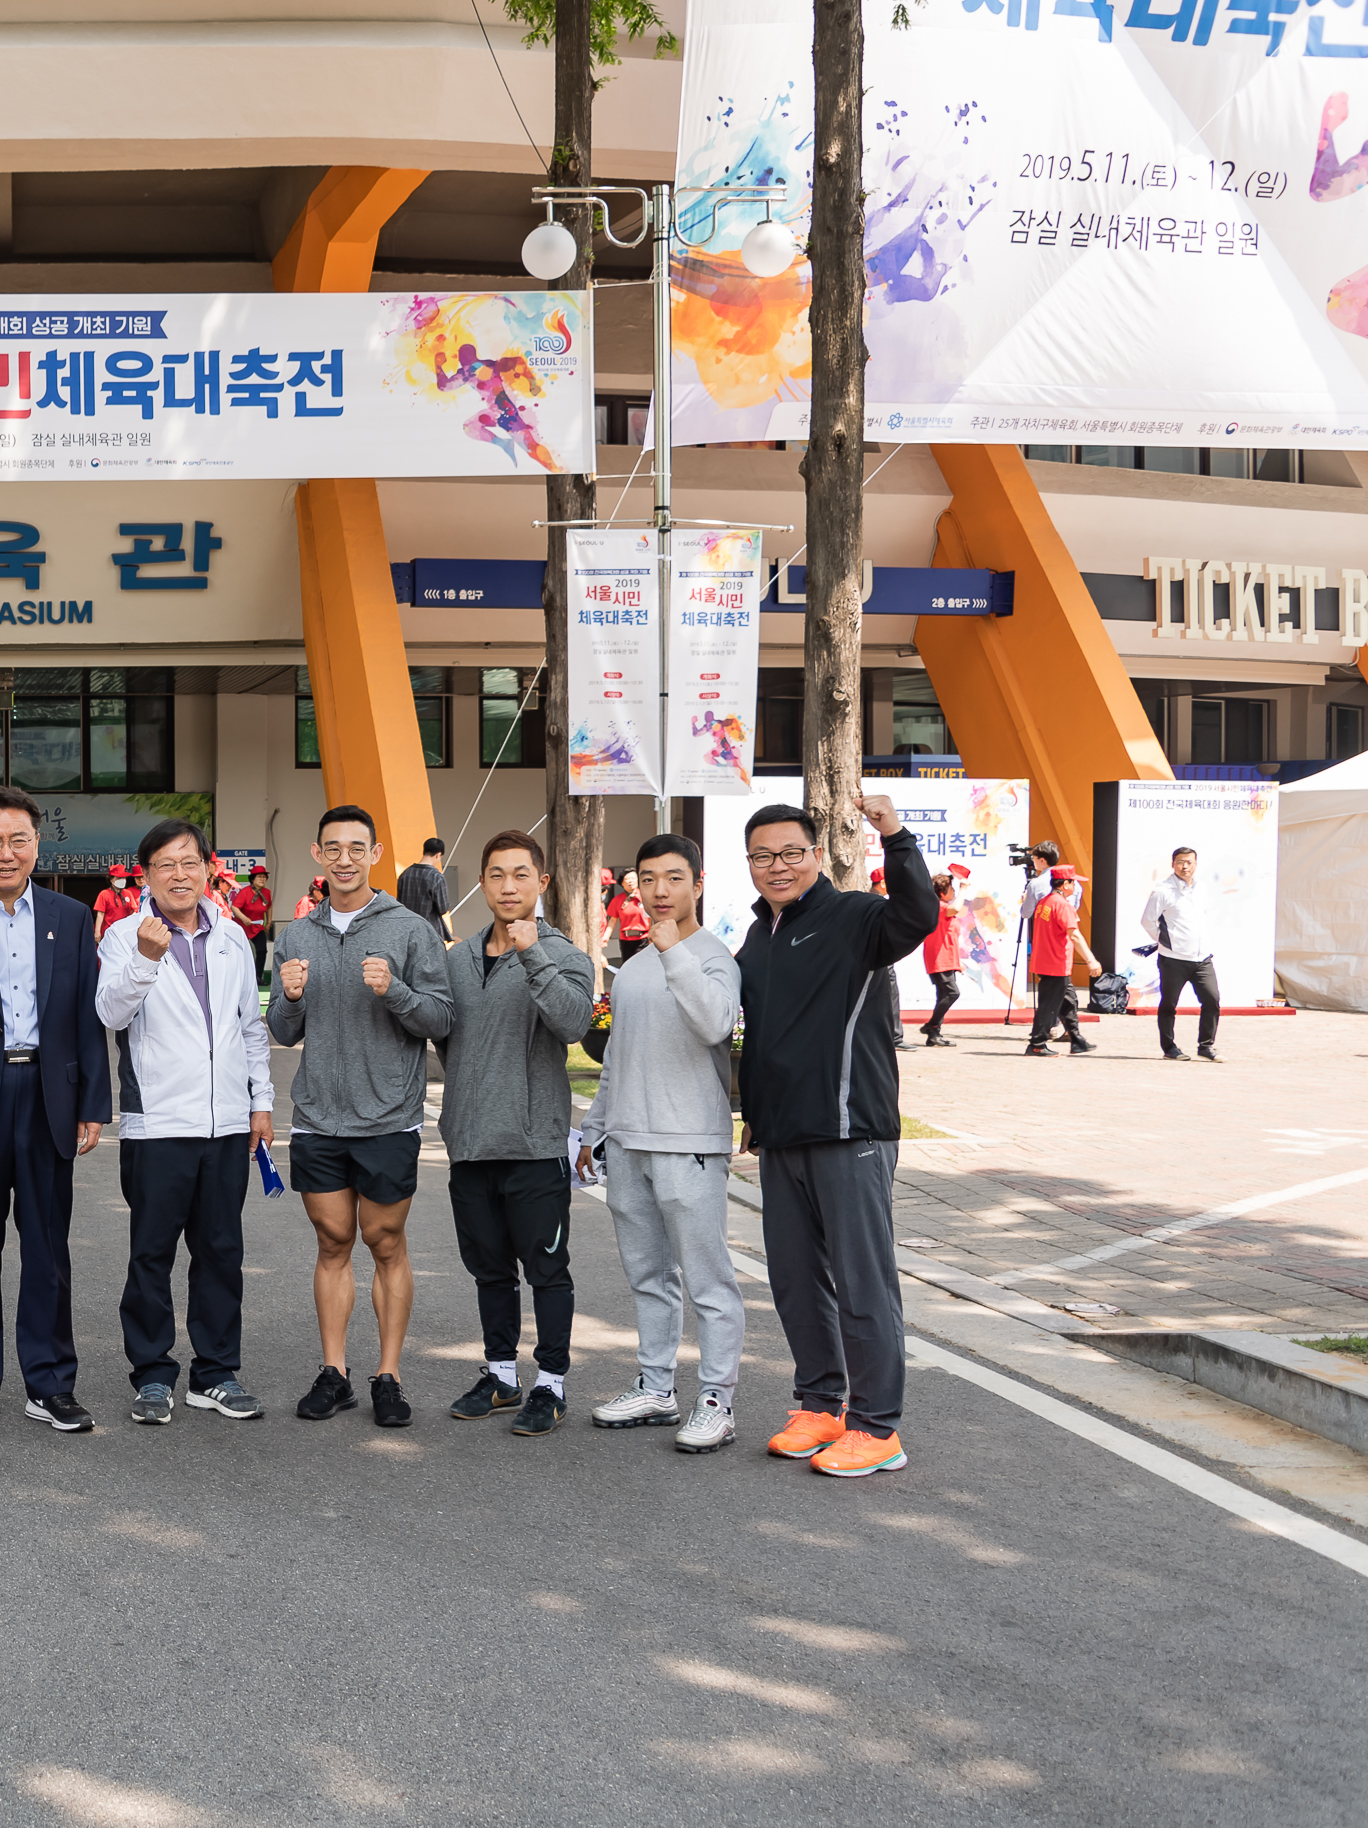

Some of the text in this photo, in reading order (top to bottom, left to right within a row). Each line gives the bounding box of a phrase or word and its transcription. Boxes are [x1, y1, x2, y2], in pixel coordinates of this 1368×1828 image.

[1019, 150, 1178, 191] 2019.5.11.(토)
[1208, 160, 1288, 200] 12.(일)
[1008, 209, 1261, 257] 잠실 실내체육관 일원
[31, 316, 69, 335] 성공
[73, 316, 111, 335] 개최
[115, 315, 152, 335] 기원
[528, 357, 577, 366] SEOUL 2019
[970, 416, 990, 429] 주관
[998, 418, 1020, 430] 25개
[1020, 419, 1079, 432] 자치구체육회,
[1080, 420, 1127, 433] 서울특별시
[1128, 421, 1184, 435] 회원종목단체
[1197, 423, 1217, 435] 후원
[31, 432, 56, 448] 잠실
[60, 432, 123, 447] 실내체육관
[126, 431, 152, 447] 일원
[12, 459, 55, 469] 회원종목단체
[68, 459, 82, 469] 후원
[614, 579, 640, 588] 2019
[720, 581, 743, 590] 2019
[459, 589, 484, 600] 출입구
[1143, 556, 1326, 645] TICKET
[932, 597, 970, 609] 2층 출입구
[578, 609, 648, 626] 체육대축전
[681, 611, 750, 627] 체육대축전
[918, 767, 965, 778] TICKET
[1195, 784, 1212, 792] 2019
[1128, 798, 1164, 809] 제100회
[1166, 799, 1221, 810] 전국체육대회
[906, 811, 923, 821] 개최
[924, 811, 942, 821] 기원
